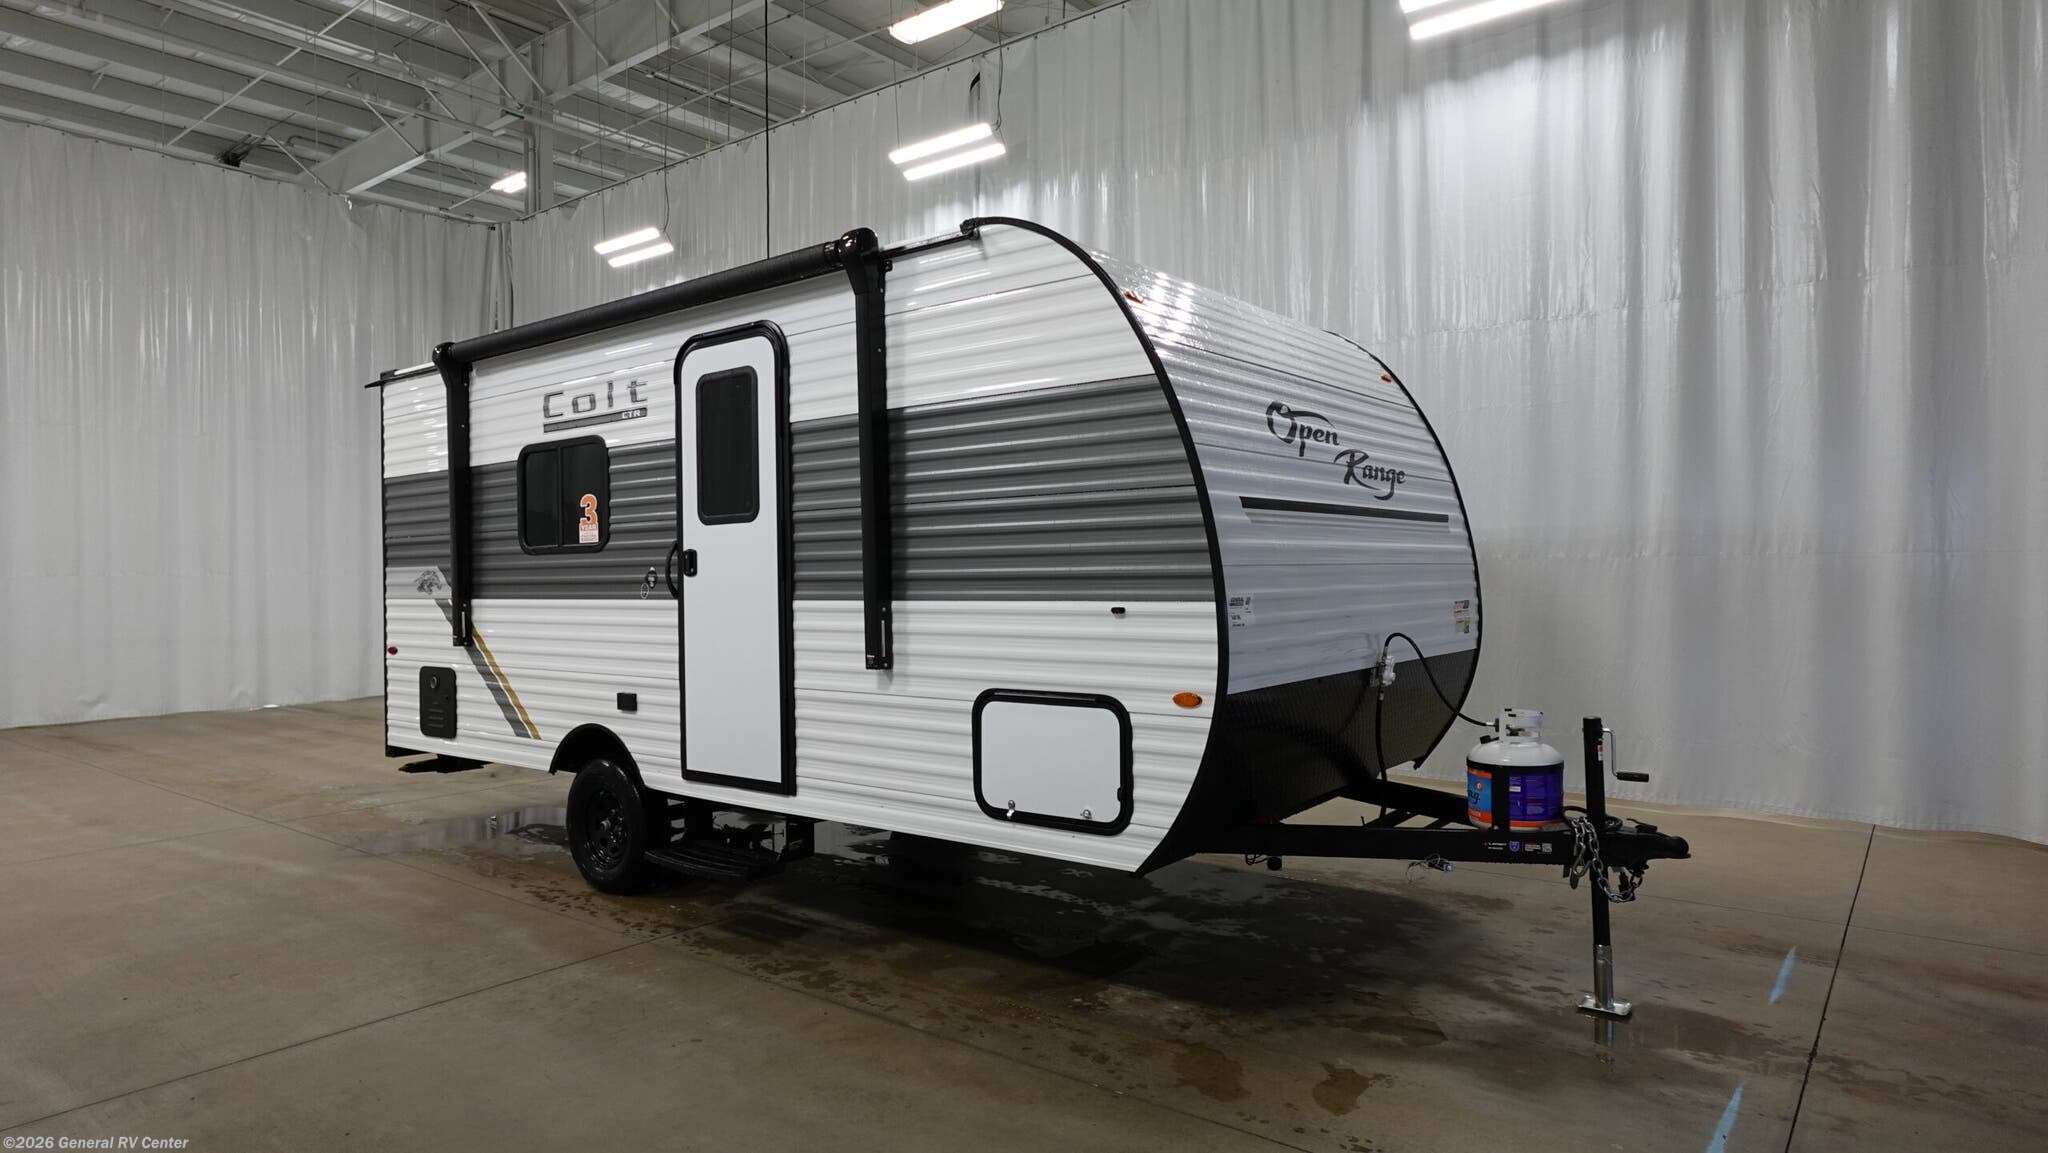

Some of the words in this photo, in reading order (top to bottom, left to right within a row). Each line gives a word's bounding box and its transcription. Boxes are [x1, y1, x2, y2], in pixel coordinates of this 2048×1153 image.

[543, 380, 648, 418] Colt
[1265, 401, 1340, 457] Open
[1333, 449, 1406, 501] Range
[580, 494, 598, 525] 3
